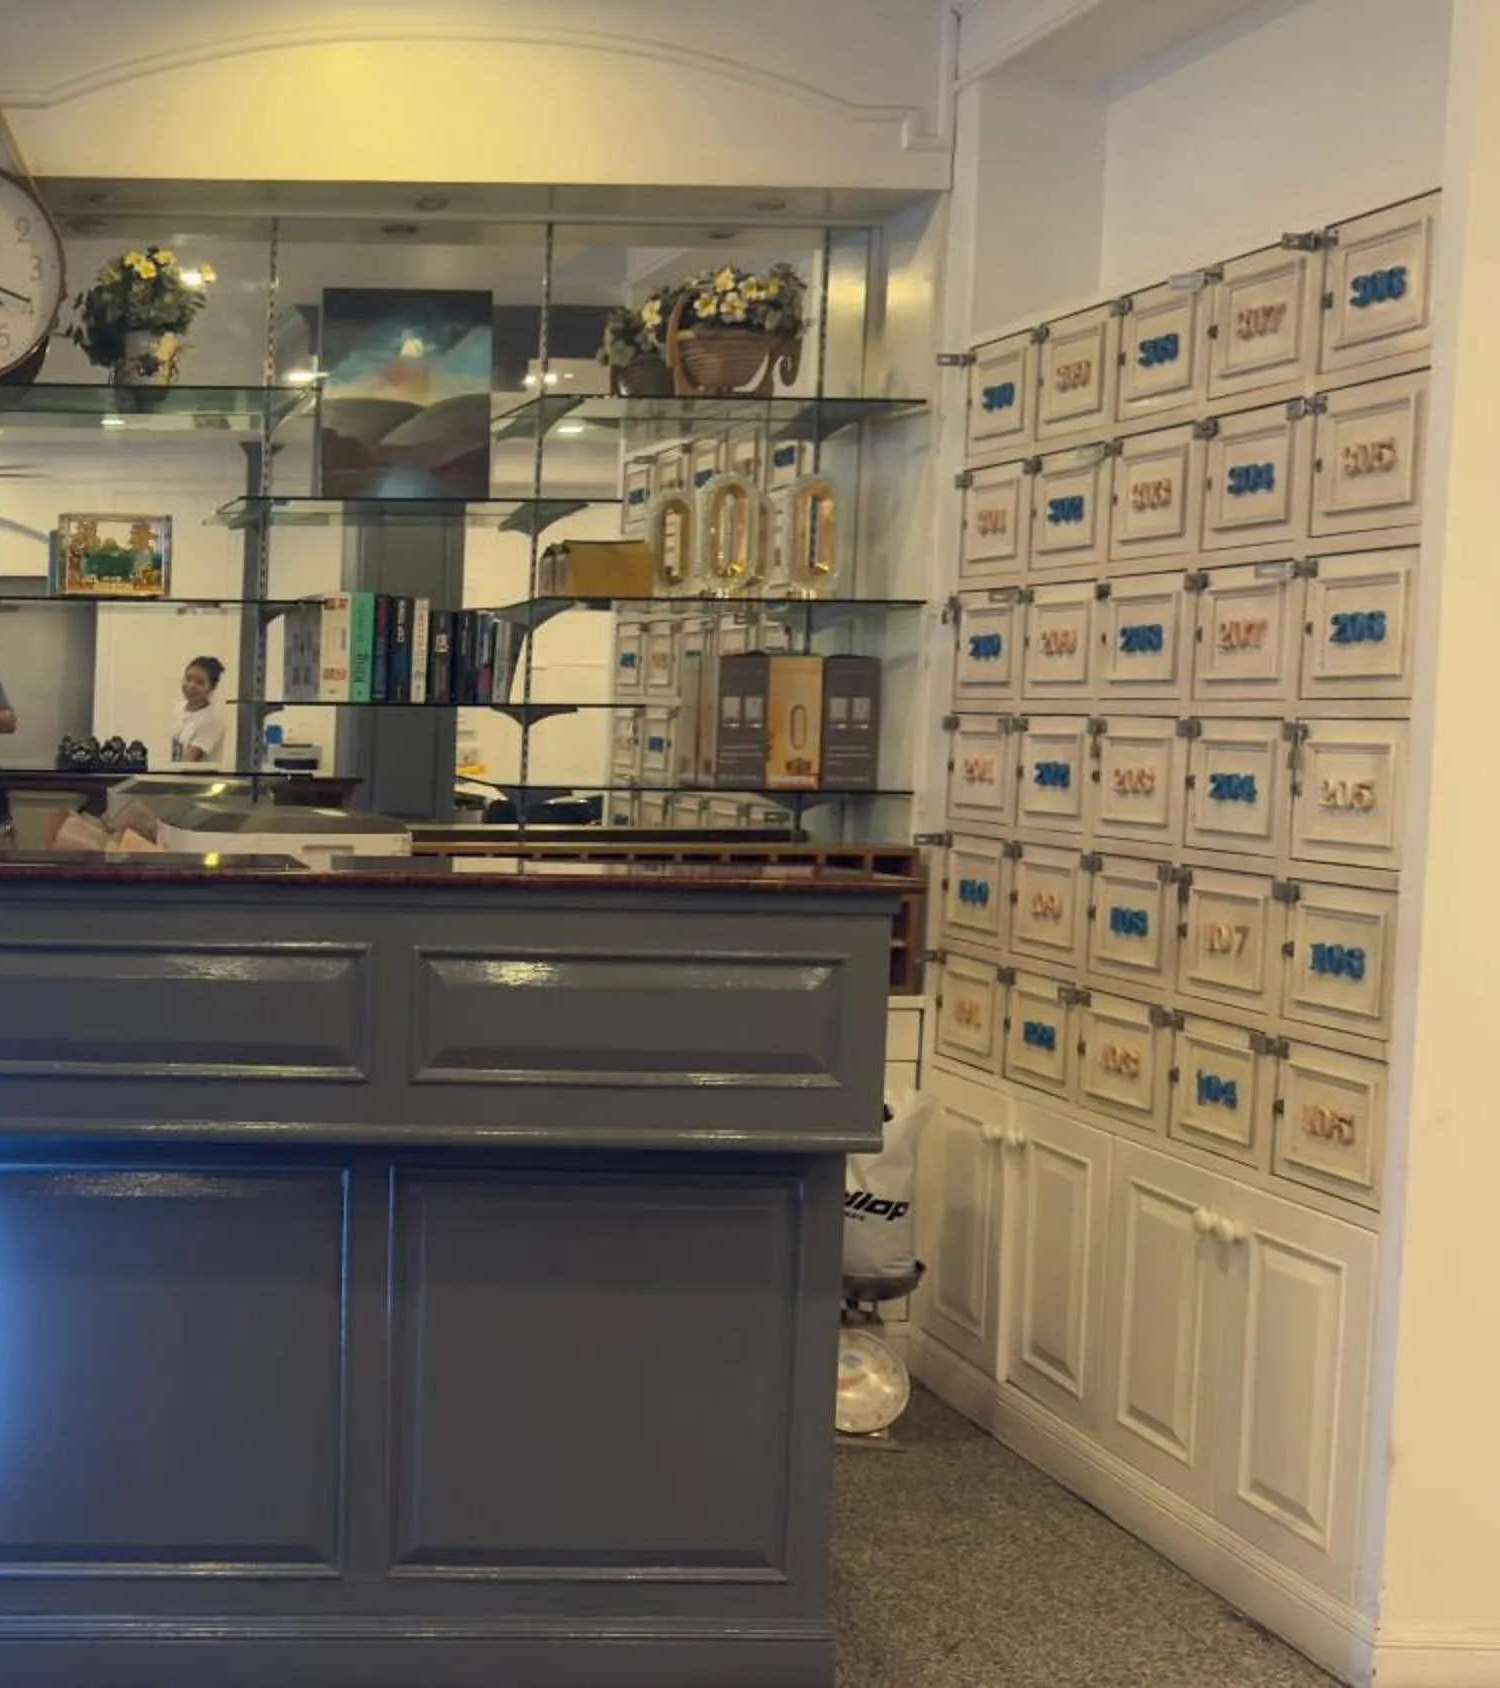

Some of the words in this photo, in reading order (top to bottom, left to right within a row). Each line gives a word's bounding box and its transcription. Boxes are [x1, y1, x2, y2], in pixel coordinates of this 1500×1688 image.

[16, 217, 32, 244] 2
[29, 255, 43, 281] 3
[20, 297, 35, 318] 4
[1328, 609, 1388, 645] 206
[1319, 778, 1377, 813] 205
[1203, 922, 1250, 959] 107
[1308, 942, 1366, 981] 106
[1197, 1069, 1237, 1111] 104
